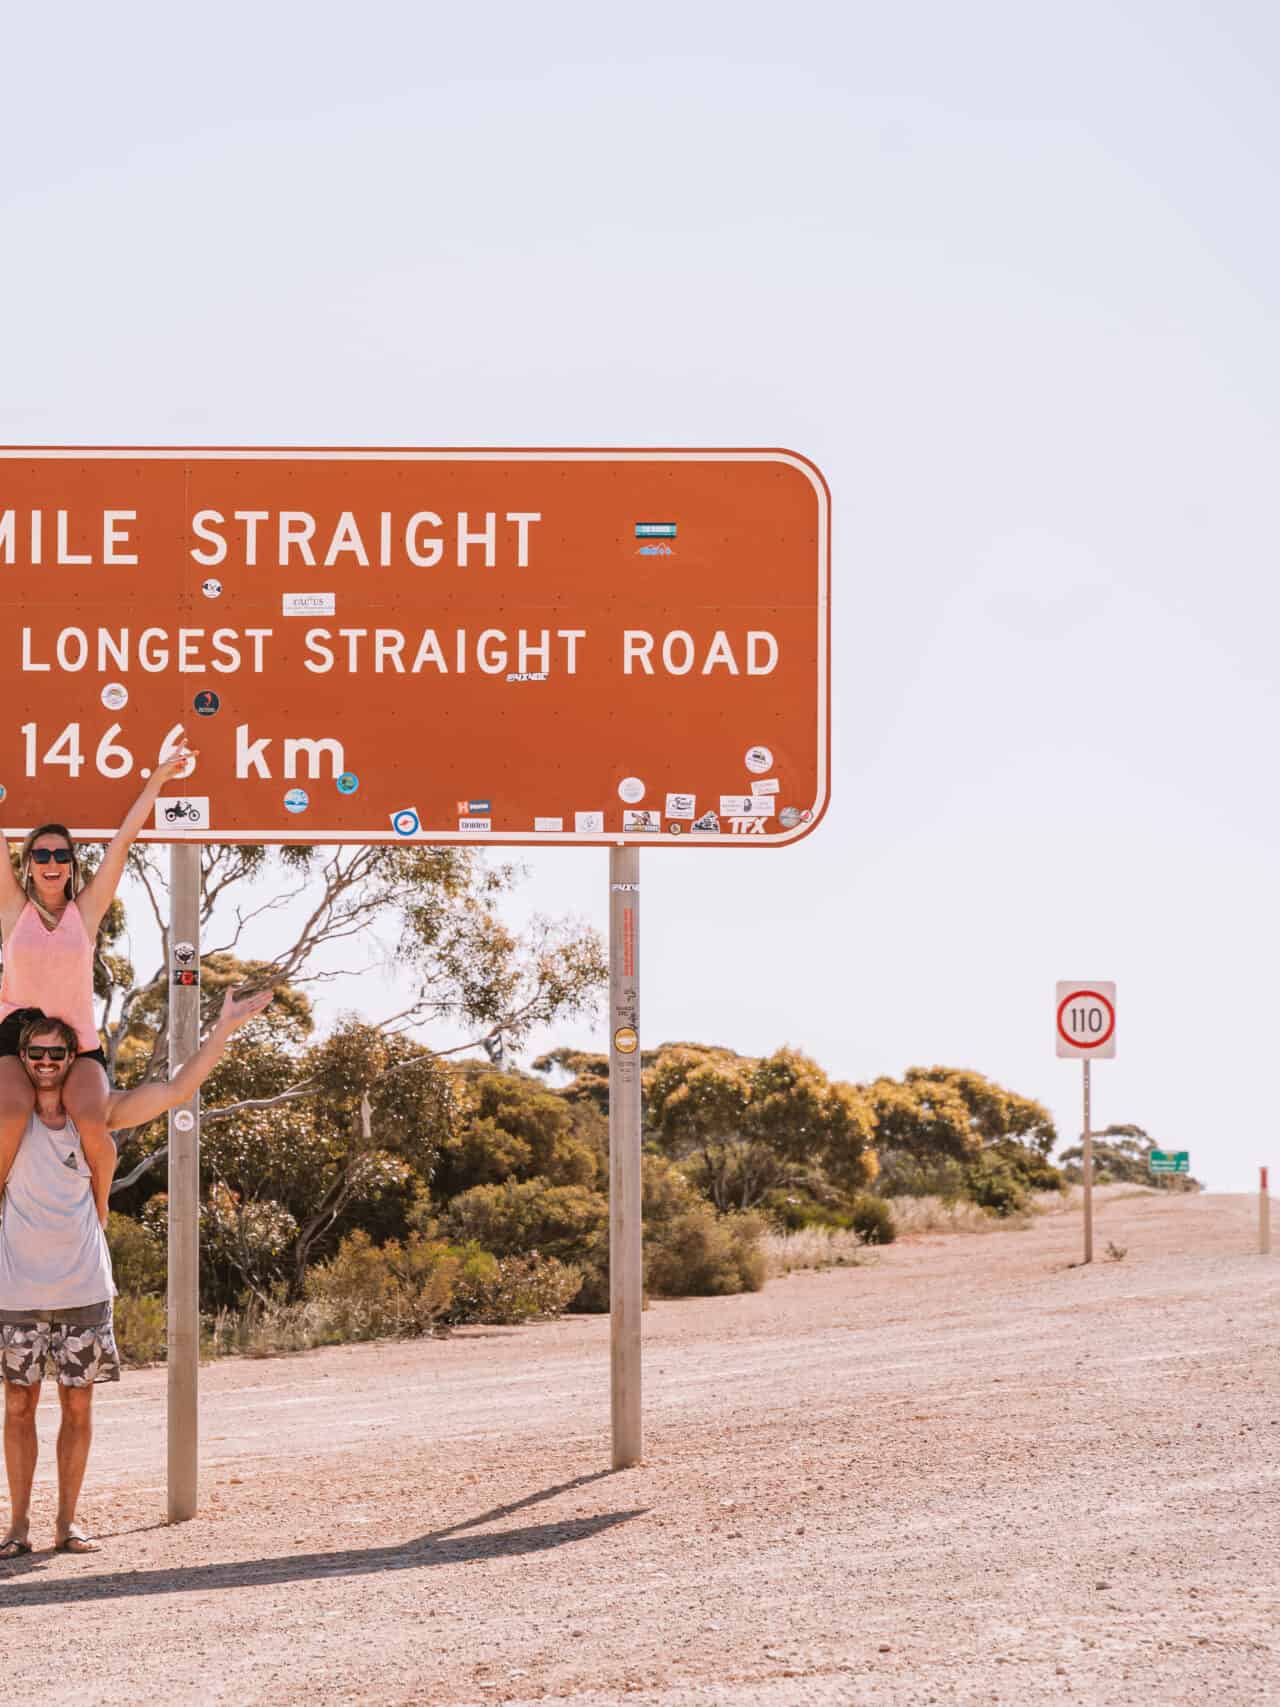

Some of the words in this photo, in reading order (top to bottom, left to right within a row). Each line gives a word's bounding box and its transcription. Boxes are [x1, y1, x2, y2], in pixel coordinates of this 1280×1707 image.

[190, 509, 542, 567] STRAIGHT
[22, 626, 273, 673] LONGEST
[303, 628, 586, 675] STRAIGHT
[623, 629, 779, 676] ROAD
[21, 722, 197, 779] 146.6
[235, 723, 345, 779] km
[1071, 1007, 1103, 1033] 110
